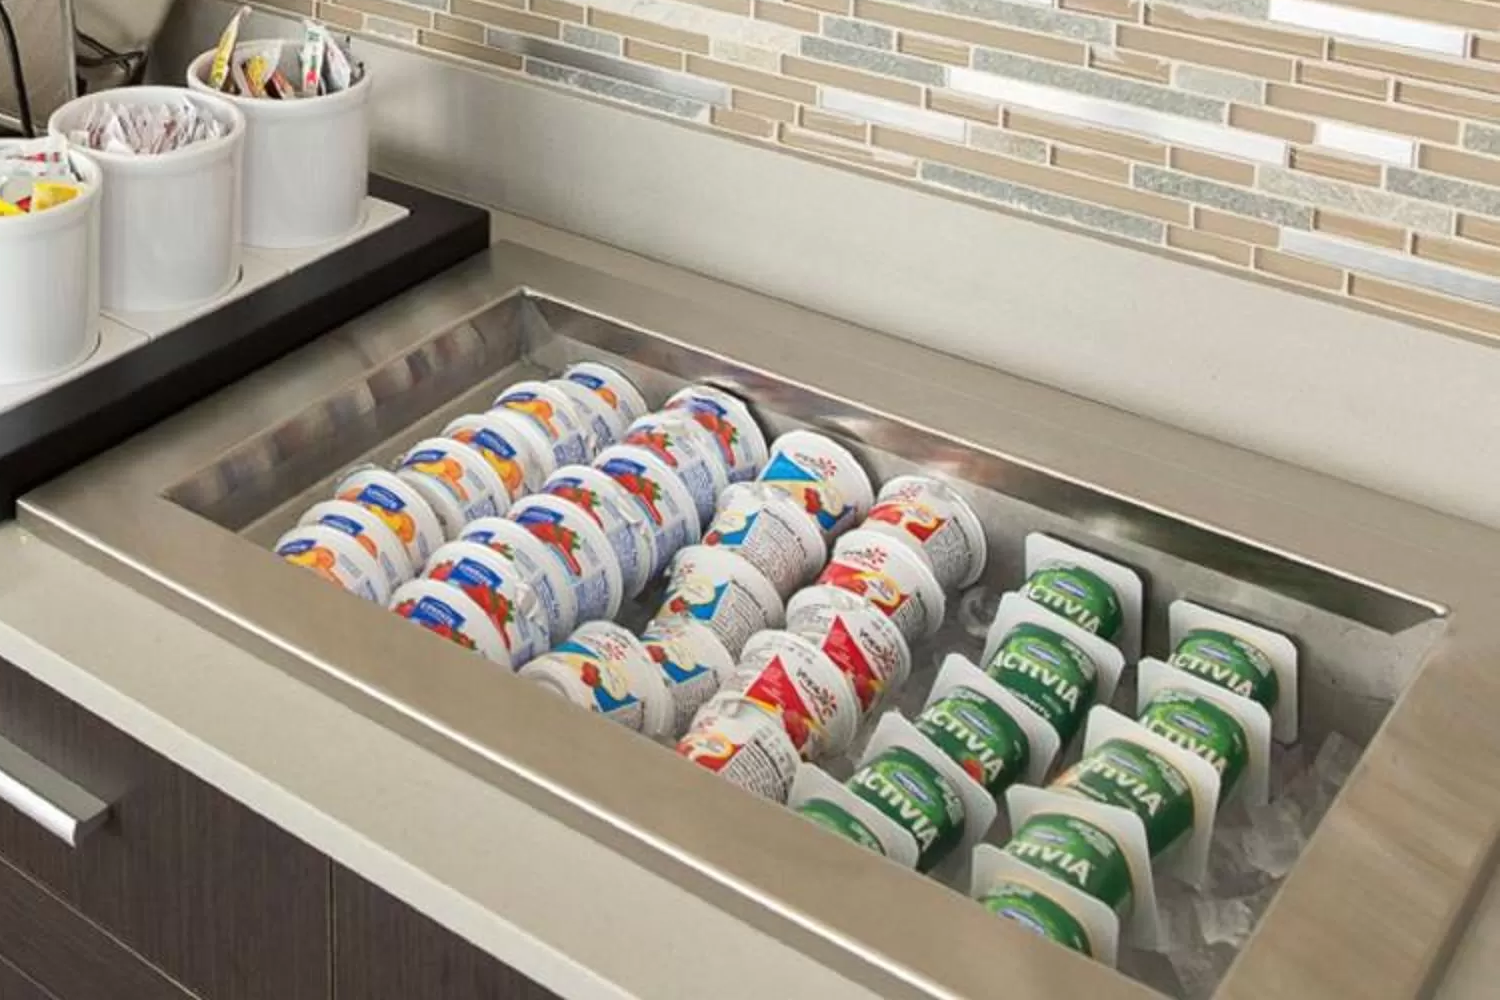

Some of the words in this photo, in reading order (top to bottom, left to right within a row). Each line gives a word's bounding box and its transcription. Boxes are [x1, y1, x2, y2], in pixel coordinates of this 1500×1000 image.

[992, 651, 1080, 713] ACTIVIA
[916, 707, 1005, 782] ACTIVIA
[853, 767, 940, 852] ACTIVIA
